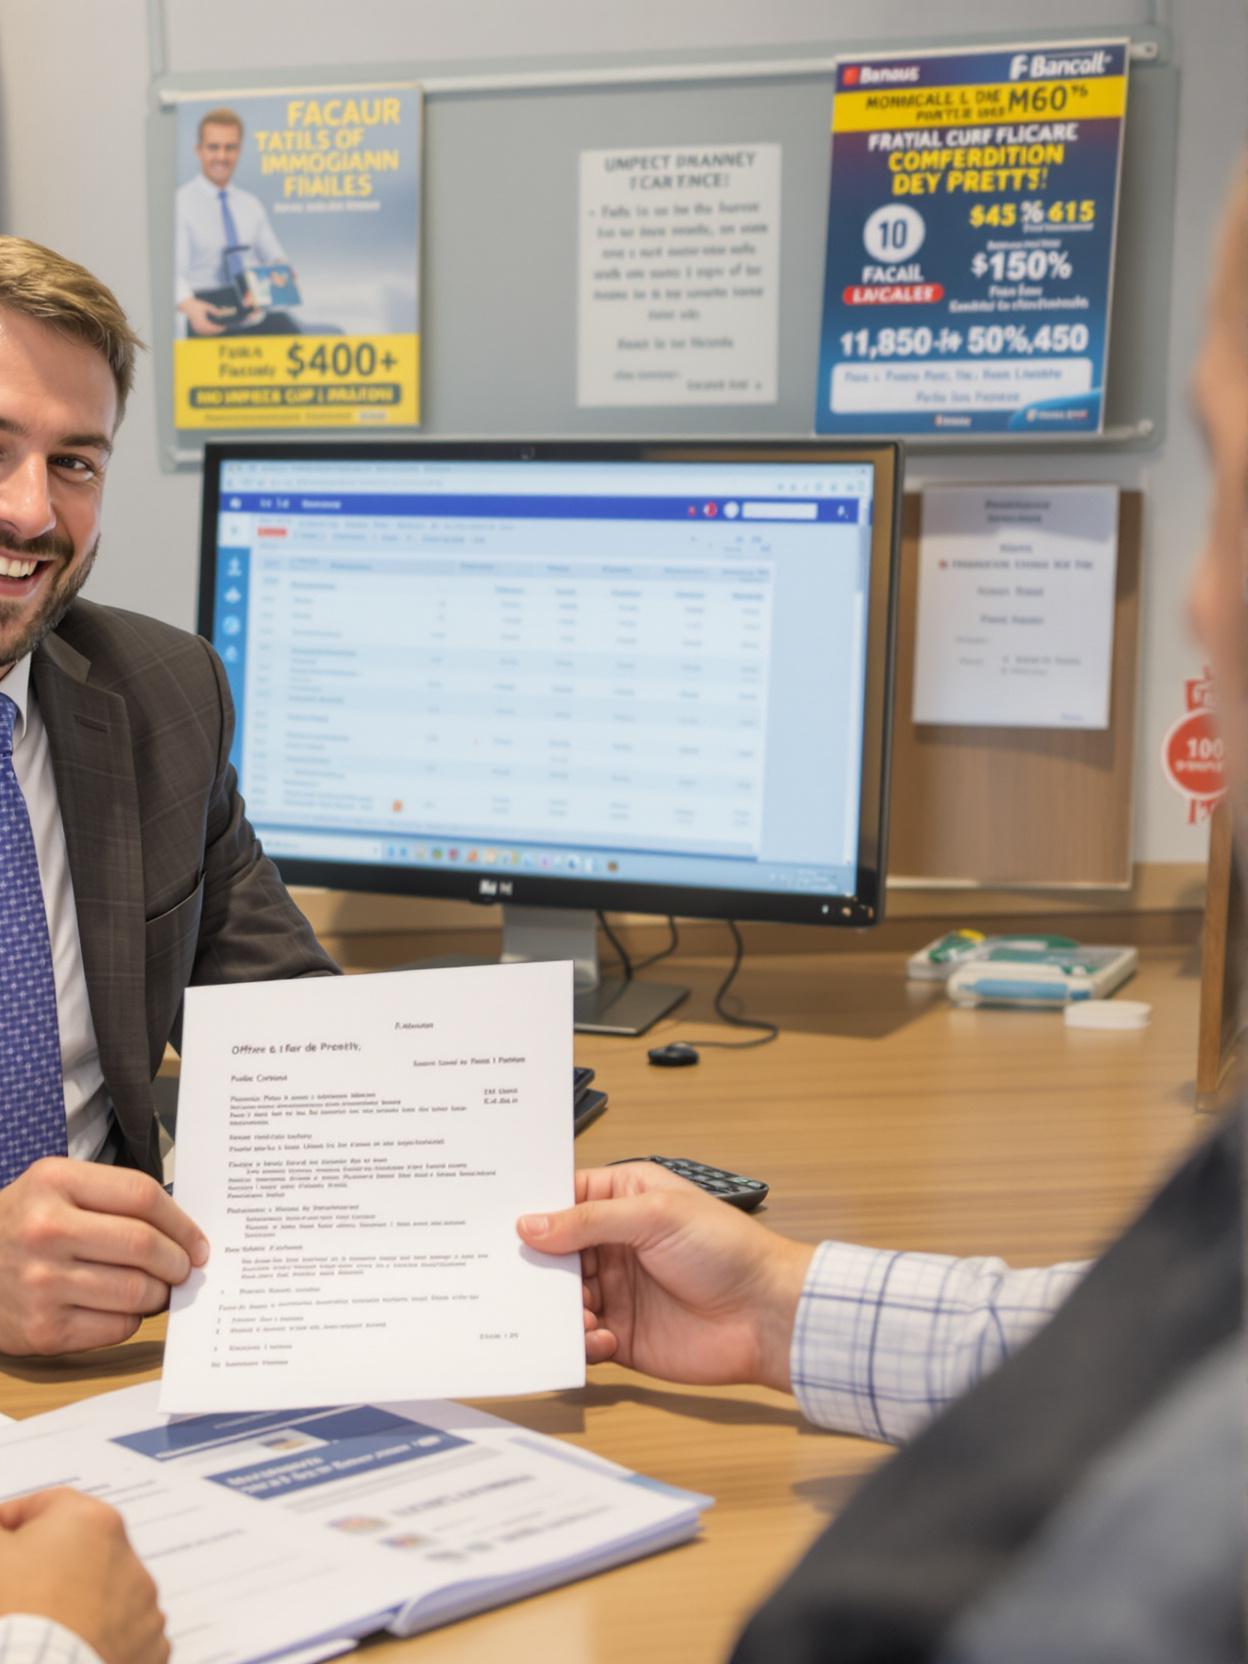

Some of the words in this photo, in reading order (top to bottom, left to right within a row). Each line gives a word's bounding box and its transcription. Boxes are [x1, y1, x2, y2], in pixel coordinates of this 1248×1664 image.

[287, 96, 401, 128] FACAUR
[892, 172, 941, 195] DEY
[878, 219, 908, 249] 10
[971, 250, 1073, 281] $150%
[286, 342, 398, 379] $400+
